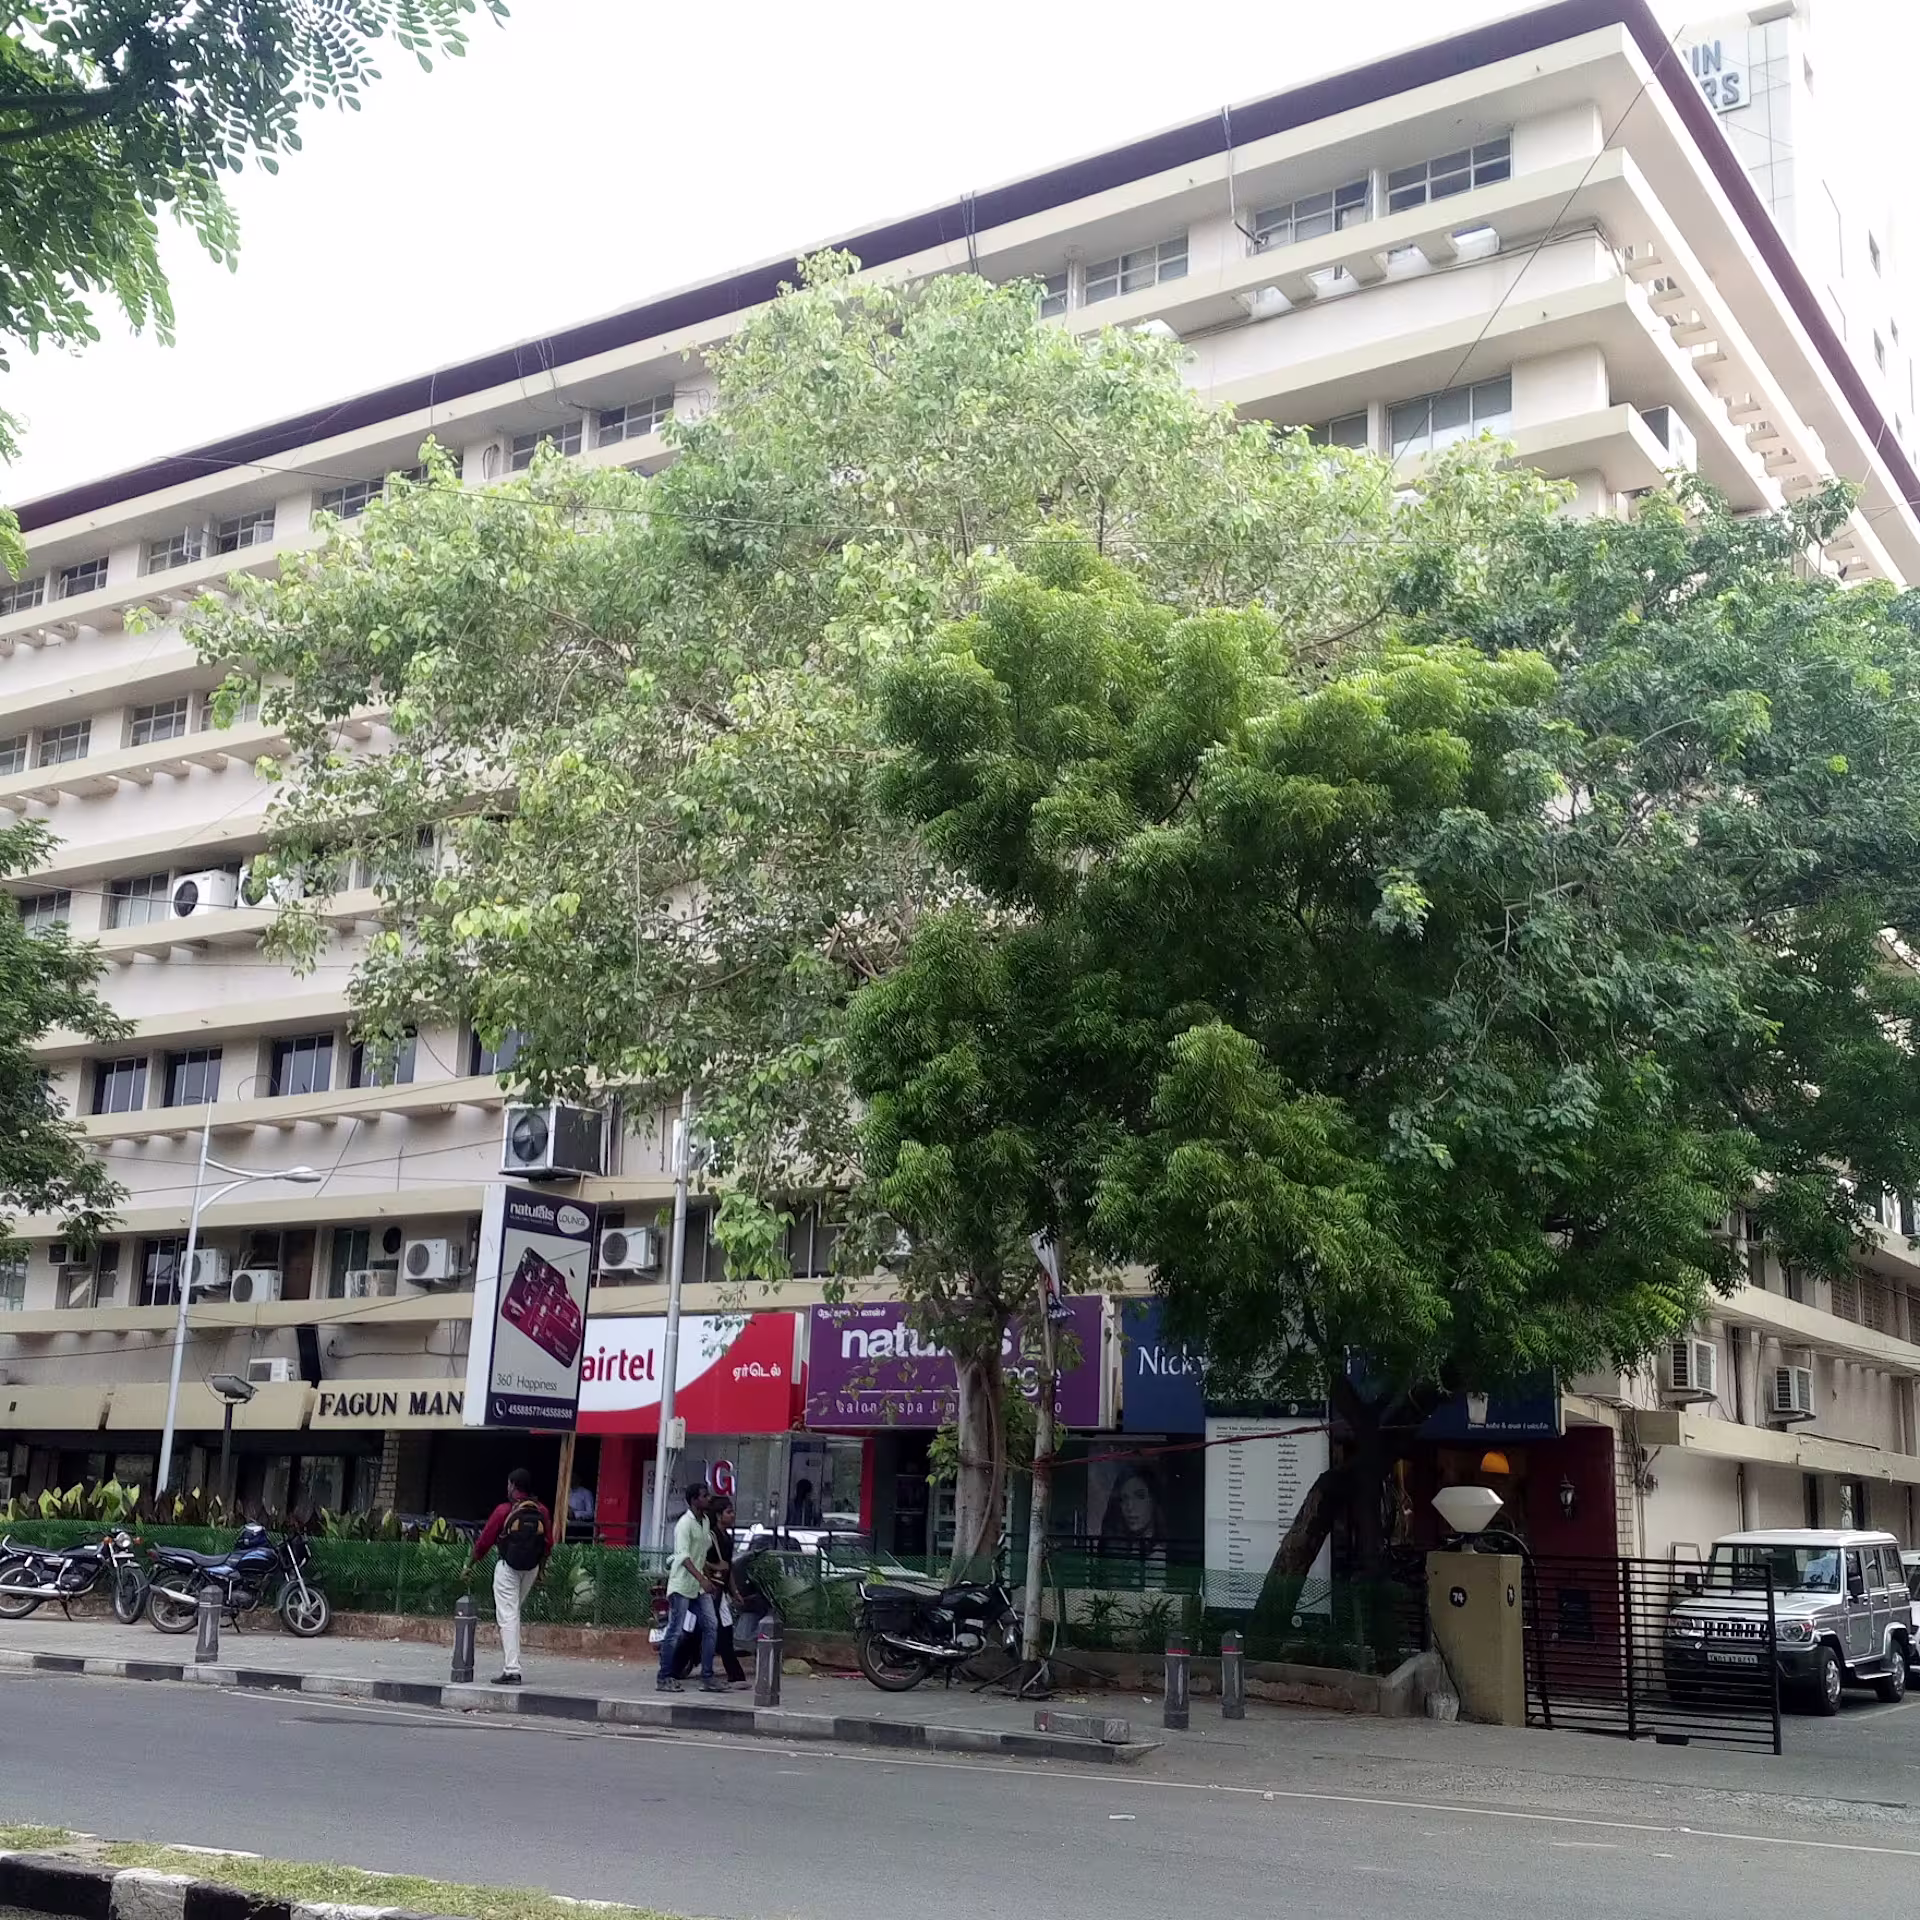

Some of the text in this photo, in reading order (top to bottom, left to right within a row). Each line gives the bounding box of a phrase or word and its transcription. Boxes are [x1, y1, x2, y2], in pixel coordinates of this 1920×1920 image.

[1682, 40, 1721, 77] IN
[510, 1203, 555, 1221] naturals
[558, 1214, 586, 1227] LOUNGE
[842, 1322, 1013, 1358] natus
[581, 1346, 654, 1382] airtel
[517, 1375, 558, 1392] Happiness
[318, 1390, 464, 1416] FAGUN MAN
[899, 1403, 924, 1416] spa
[1452, 1592, 1464, 1603] 74
